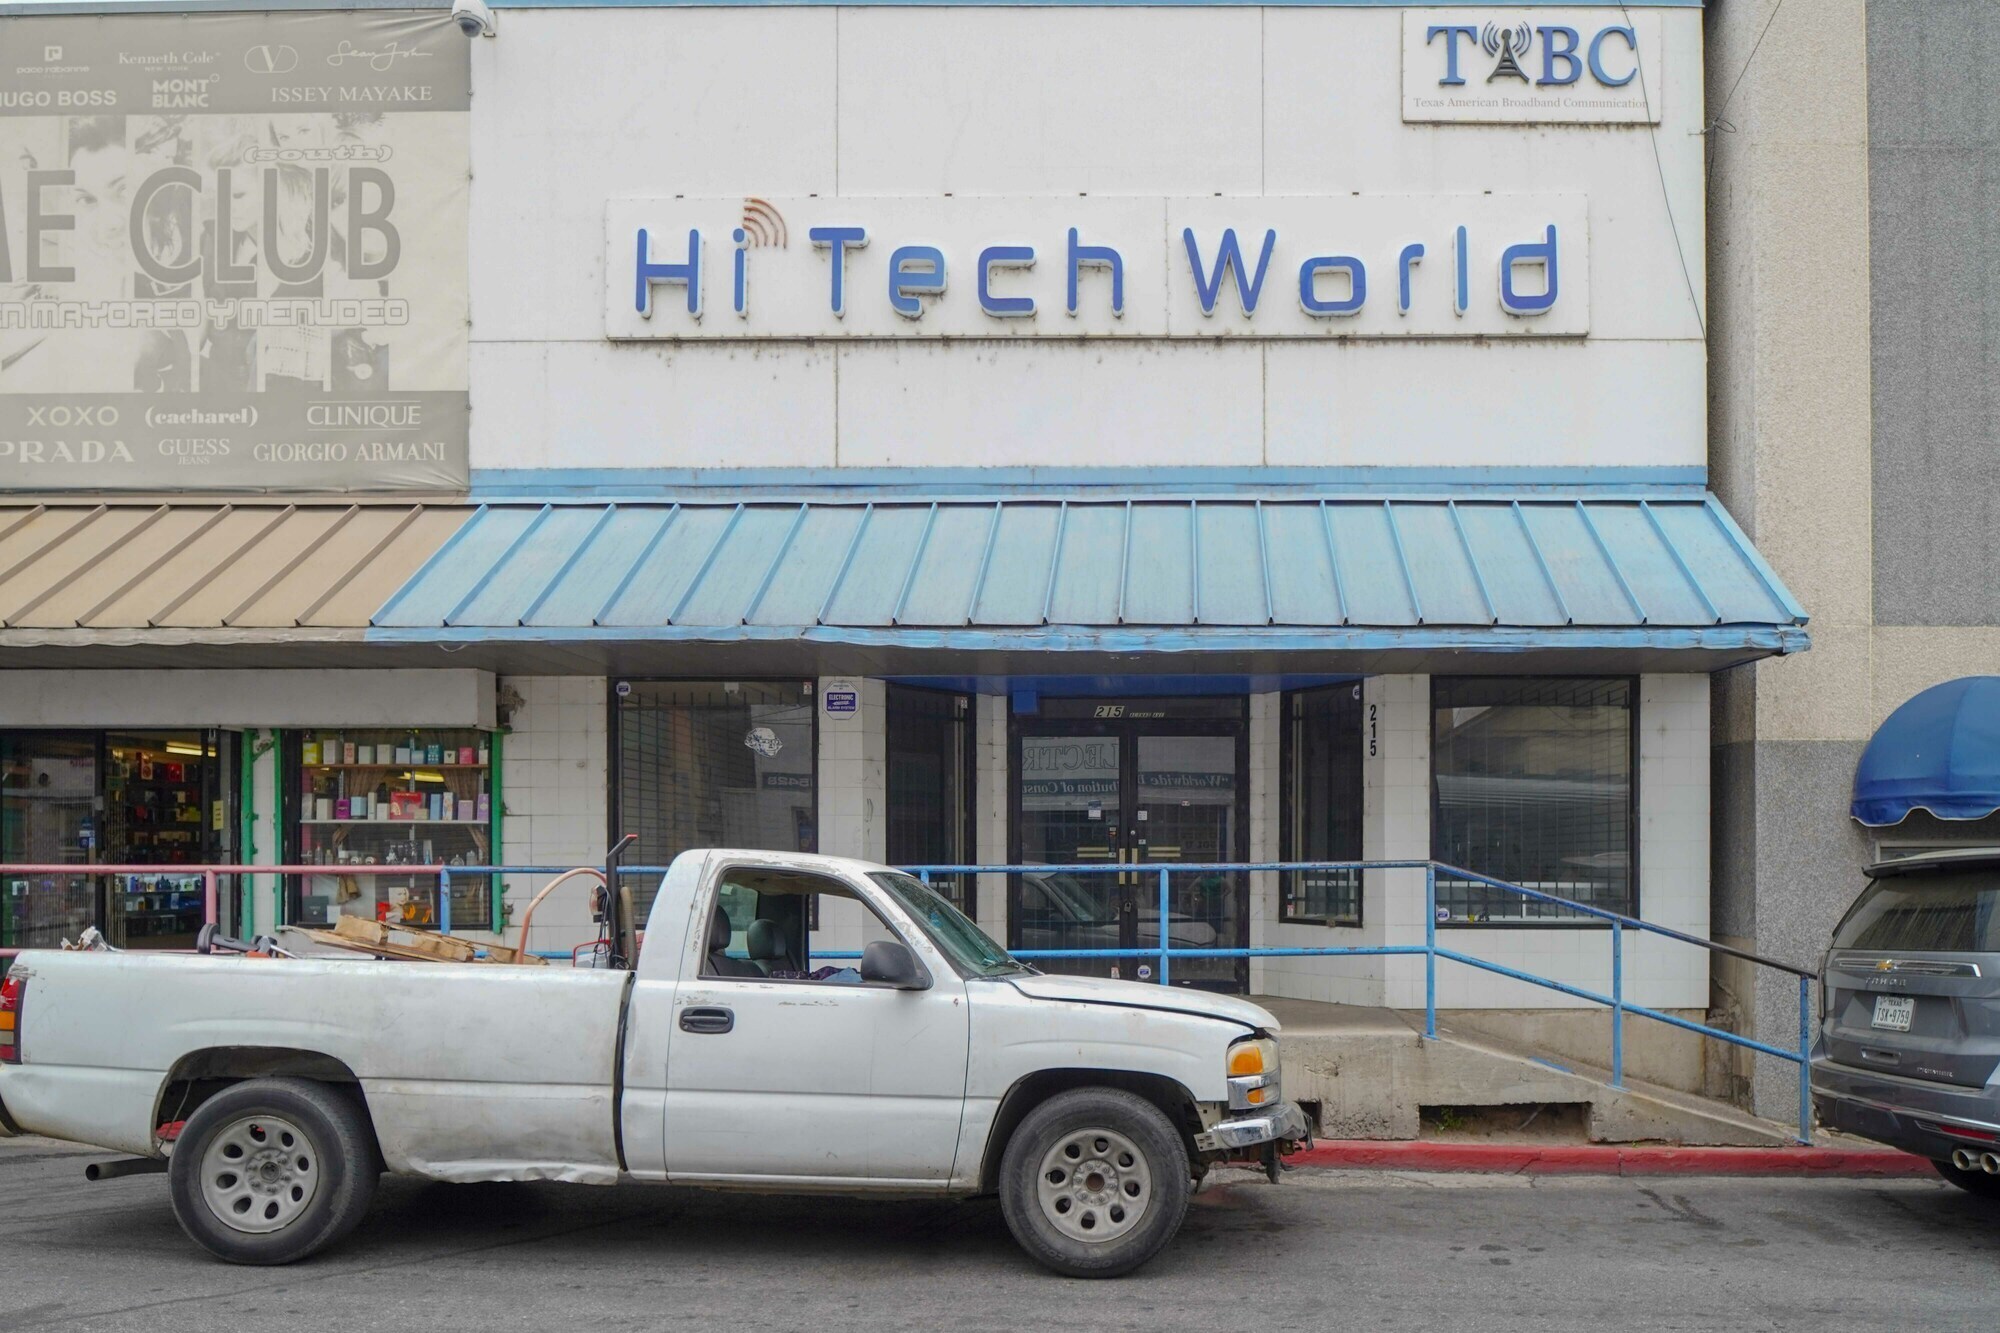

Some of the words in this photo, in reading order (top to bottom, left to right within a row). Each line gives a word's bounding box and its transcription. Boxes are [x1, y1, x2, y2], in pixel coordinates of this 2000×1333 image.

[118, 51, 178, 65] Kenneth
[182, 51, 214, 64] Cole
[1427, 21, 1637, 87] TABC
[16, 66, 43, 74] paco
[45, 65, 90, 73] rabanne
[152, 79, 209, 93] MONT
[271, 87, 333, 103] ISSEY
[338, 86, 433, 102] MAYAKE
[0, 91, 51, 107] UGO
[58, 90, 117, 106] BOSS
[152, 94, 209, 108] BLANC
[1413, 97, 1445, 109] Texas
[1447, 97, 1499, 109] American
[1501, 97, 1561, 109] Broadband
[243, 145, 393, 164] (south)
[129, 166, 401, 284] CLUB
[635, 227, 750, 319] Hi
[809, 227, 1124, 318] Tech
[1183, 224, 1558, 318] World
[0, 301, 27, 329] N
[31, 300, 201, 329] MAYOREO
[206, 298, 236, 330] Y
[240, 298, 409, 329] MENUDEO
[26, 405, 119, 427] XOXO
[145, 404, 259, 429] (cacharel)
[306, 404, 421, 426] CLINIQUE
[0, 440, 135, 463] PRADA
[157, 438, 231, 456] GUESS
[253, 442, 347, 462] GIORGIO
[354, 442, 446, 462] ARMANI
[177, 456, 211, 465] JEANS
[1095, 706, 1124, 718] 215
[1369, 704, 1377, 757] 215
